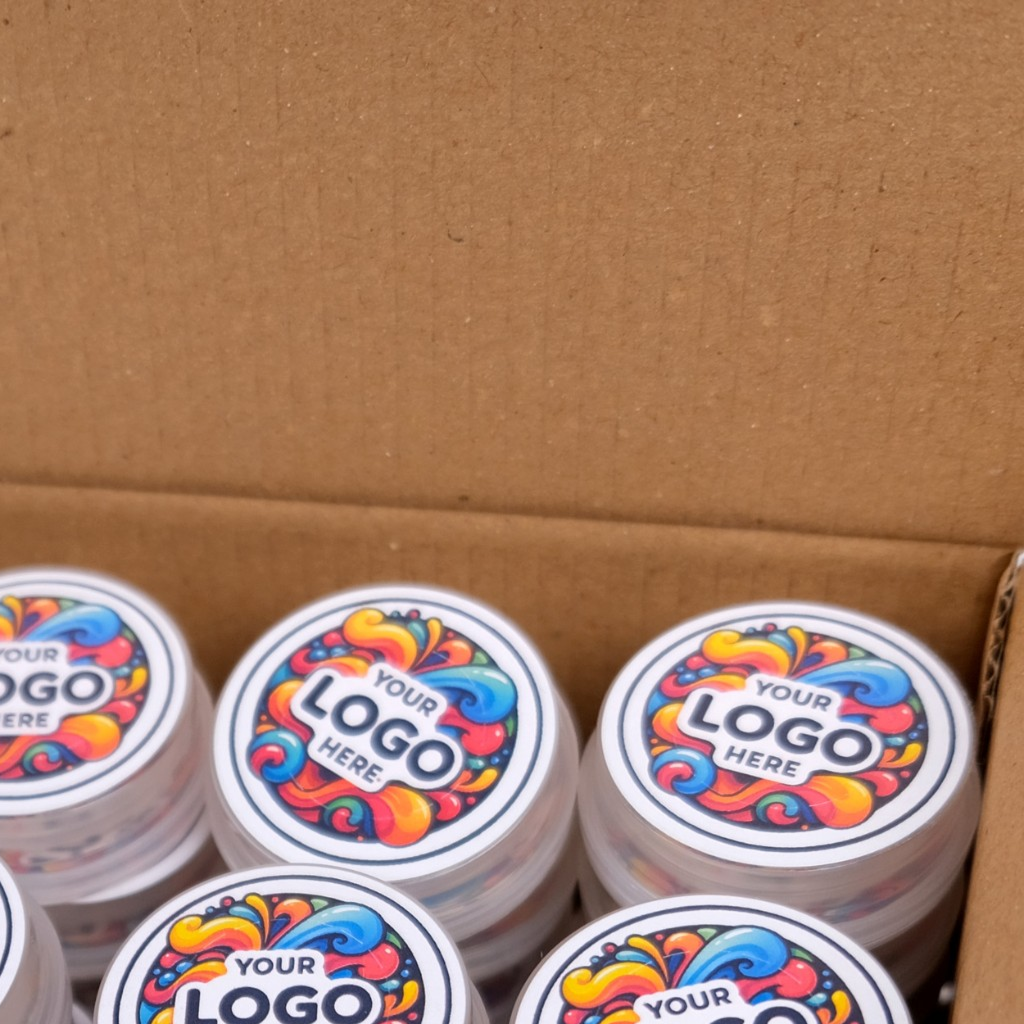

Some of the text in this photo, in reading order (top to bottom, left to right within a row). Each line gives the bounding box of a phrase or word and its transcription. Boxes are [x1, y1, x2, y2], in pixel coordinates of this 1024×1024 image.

[374, 669, 438, 717] YOUR
[756, 680, 832, 712] YOUR
[300, 675, 455, 781] LOGO
[688, 693, 872, 766] LOGO
[318, 736, 382, 784] HERE
[723, 746, 800, 778] HERE
[235, 956, 314, 975] YOUR
[643, 987, 732, 1019] YOUR
